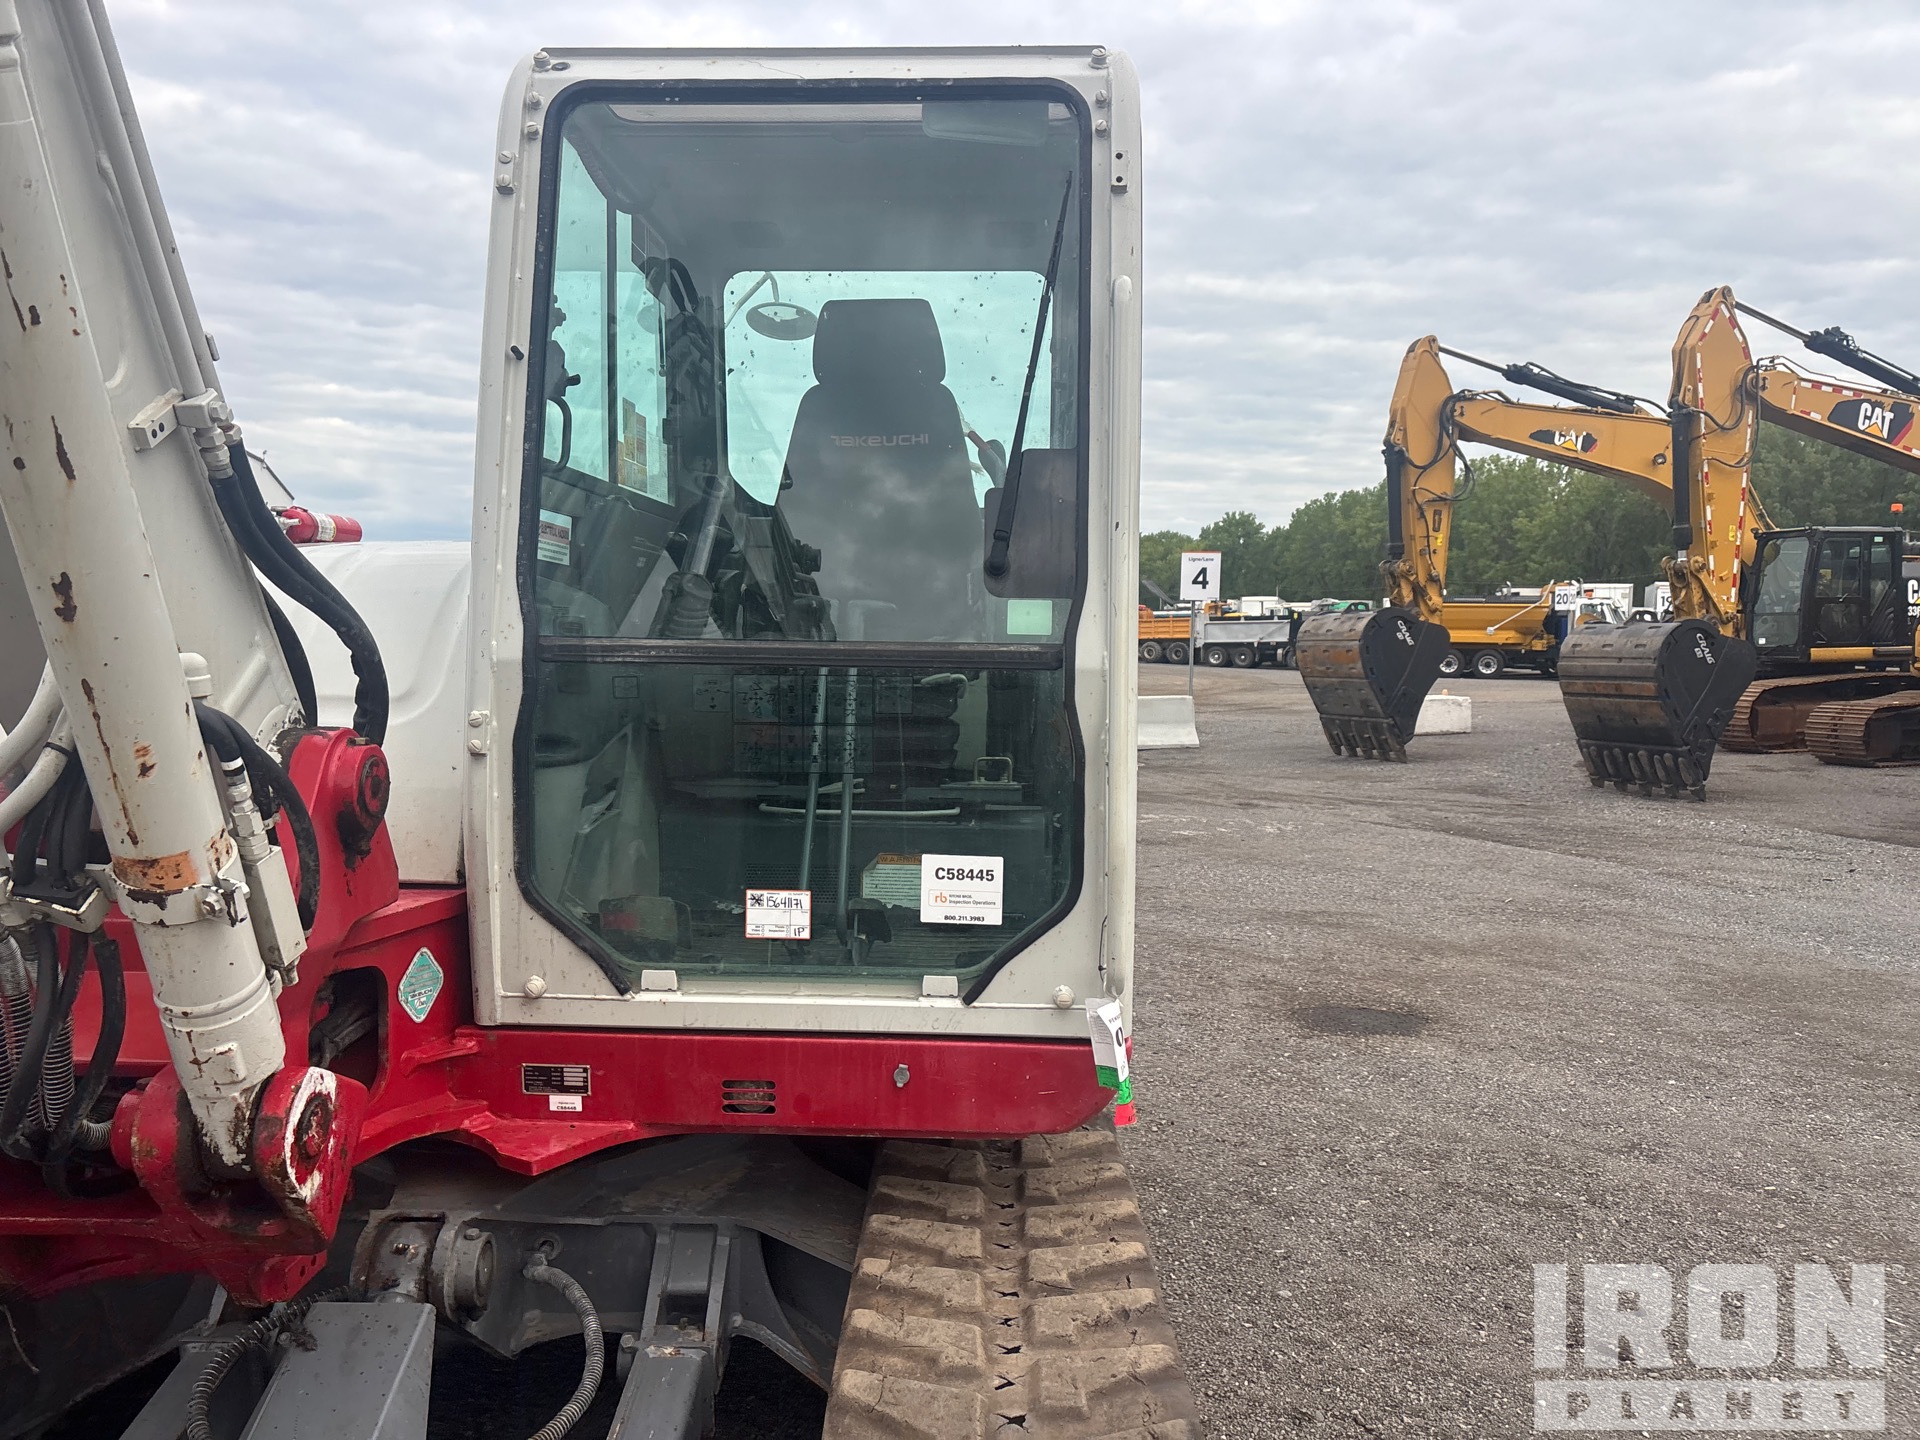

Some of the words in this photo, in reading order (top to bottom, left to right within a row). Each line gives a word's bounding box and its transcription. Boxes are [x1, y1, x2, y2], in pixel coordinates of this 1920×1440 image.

[1857, 402, 1894, 440] CAT
[1192, 567, 1209, 590] 4
[1556, 593, 1569, 605] 20
[1696, 633, 1716, 664] CRAIG
[935, 867, 995, 882] C58445
[935, 892, 948, 903] rb
